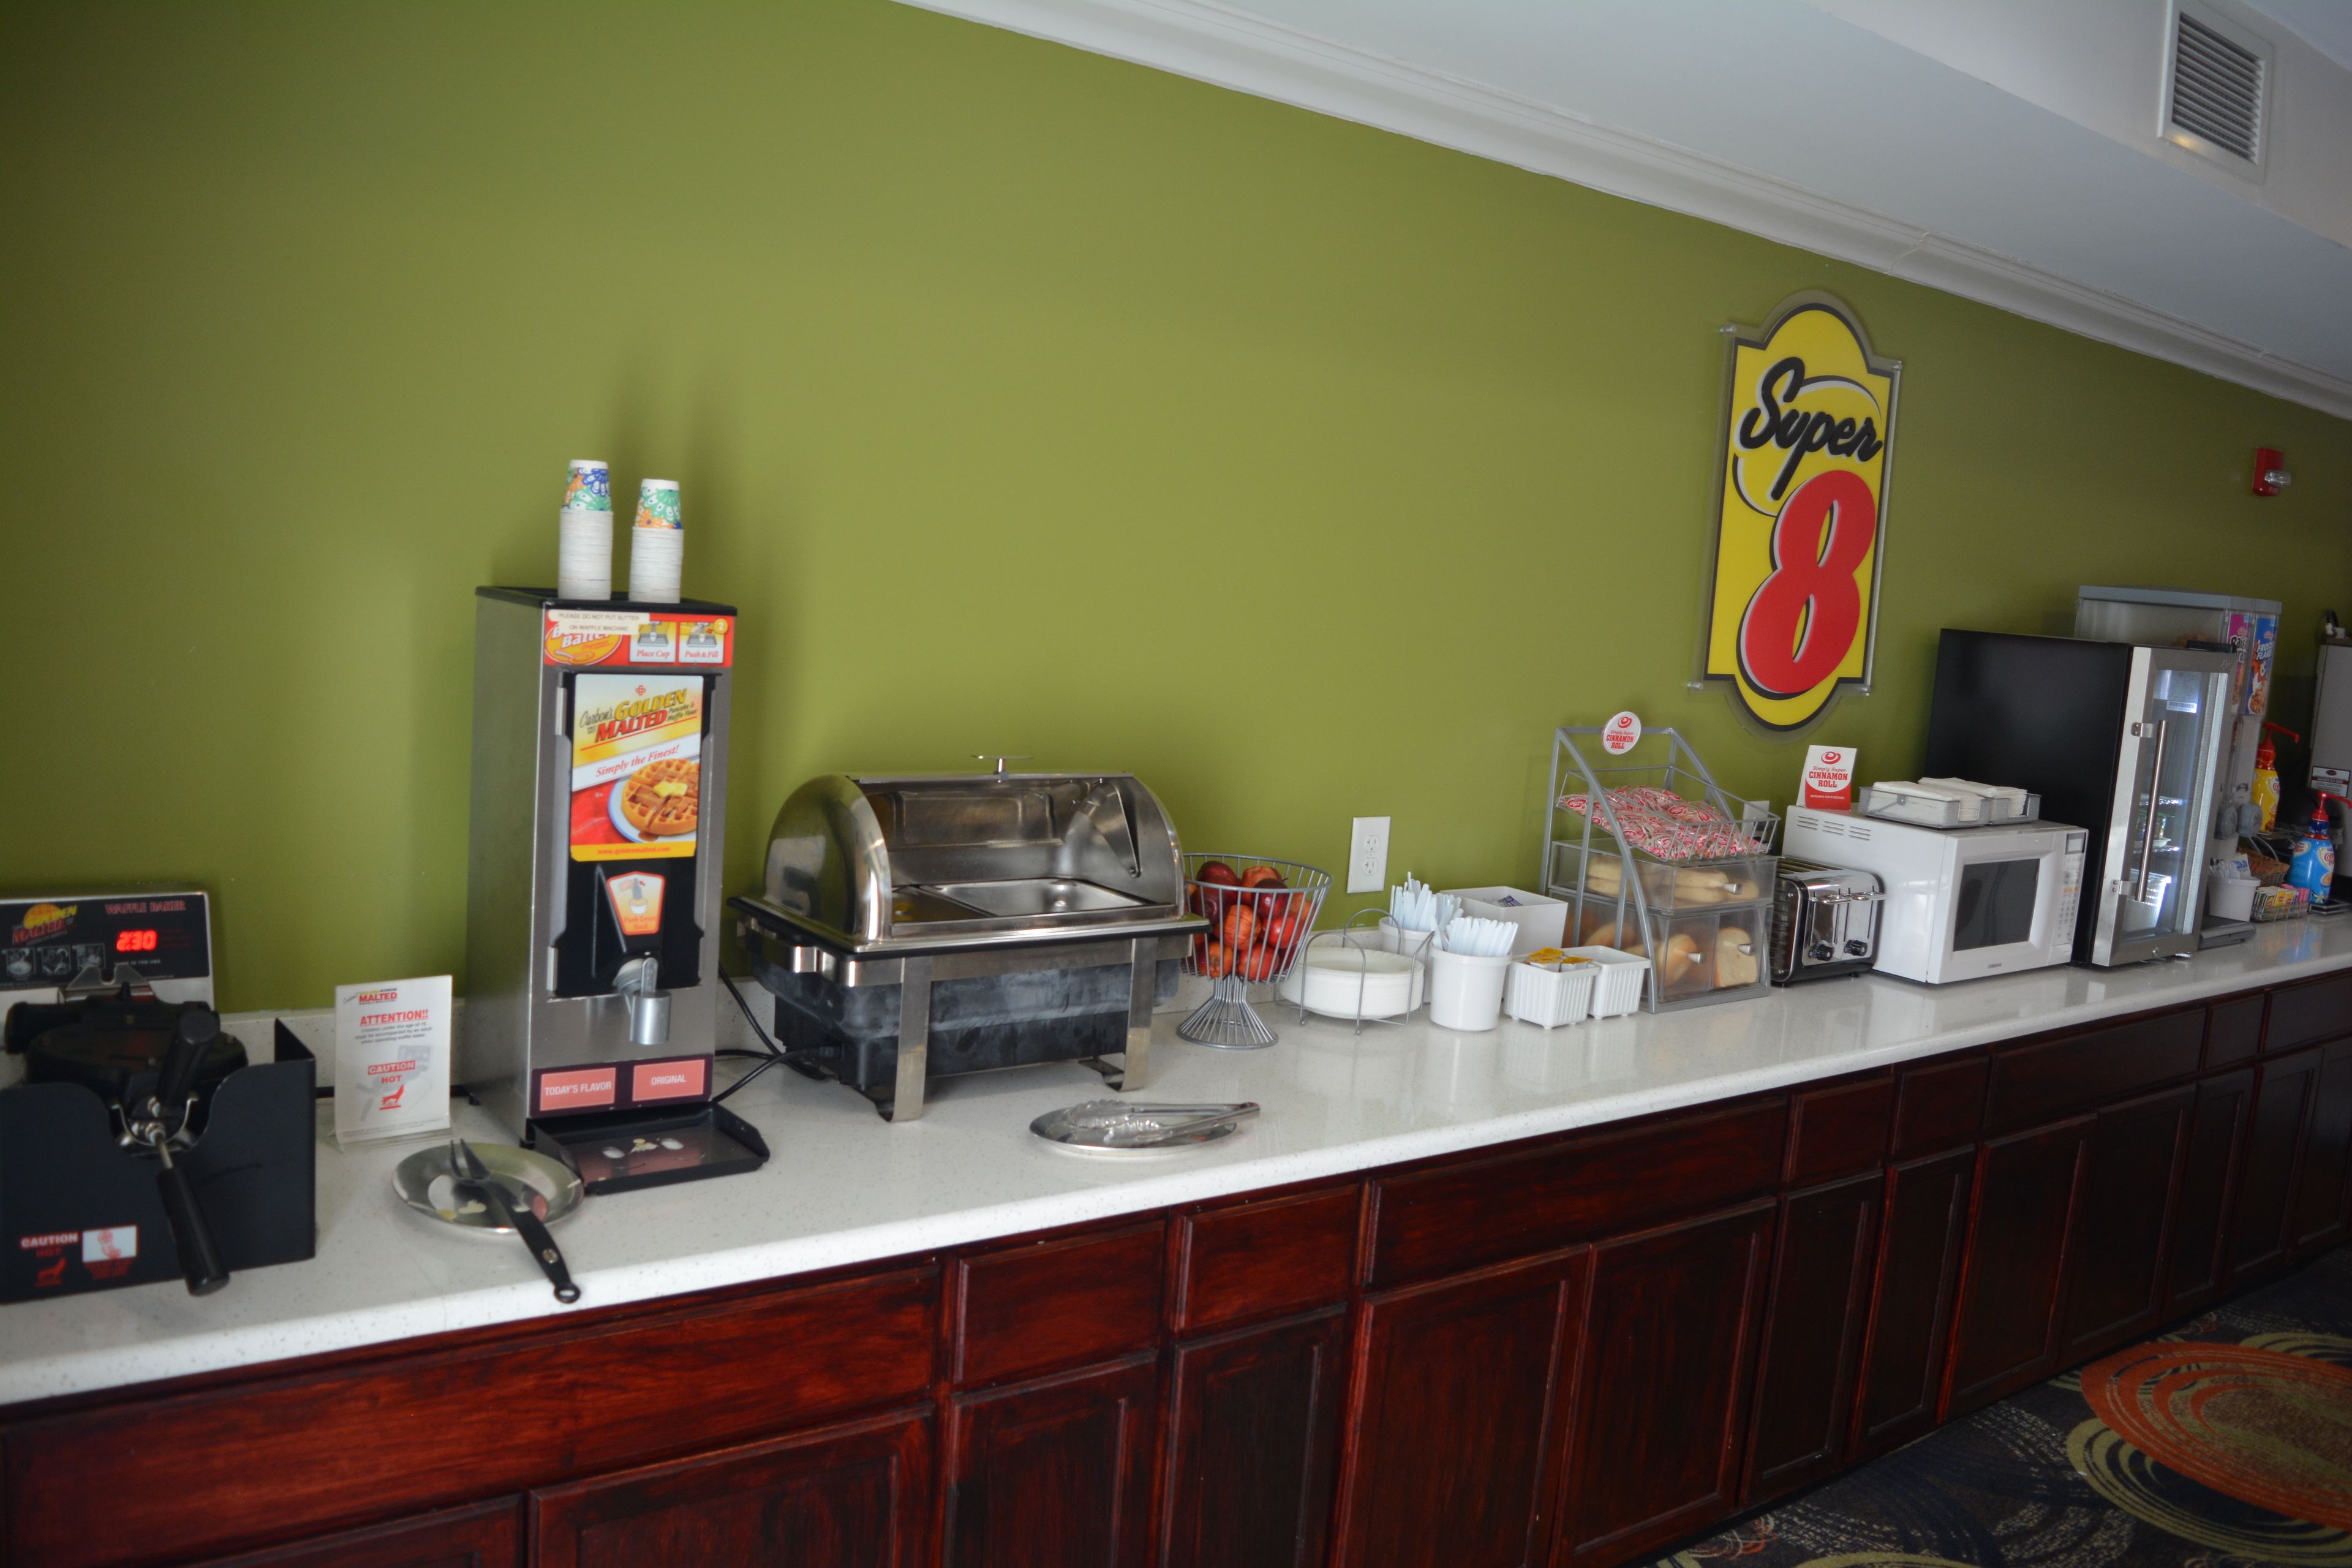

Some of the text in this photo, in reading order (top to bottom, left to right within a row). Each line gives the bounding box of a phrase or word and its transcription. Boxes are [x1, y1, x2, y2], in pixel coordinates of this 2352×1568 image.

[1735, 356, 1883, 501] Super
[1741, 470, 1876, 697] 8
[718, 622, 724, 630] 2
[614, 688, 687, 721] GOLDEN
[595, 709, 668, 743] MALTED
[595, 745, 679, 777] Simply the Finest!
[1809, 771, 1848, 780] CINNAMON
[597, 846, 670, 855] www.goldenmalted.com
[105, 900, 186, 914] WAFFLE BAKER
[359, 992, 398, 1003] MALTED
[360, 1009, 429, 1027] ATTENTION!!
[369, 1062, 415, 1074] CAUTION
[651, 1074, 686, 1085] ORIGINAL
[545, 1081, 612, 1096] TODAY'S FLAVOR
[20, 1232, 78, 1248] CAUTION
